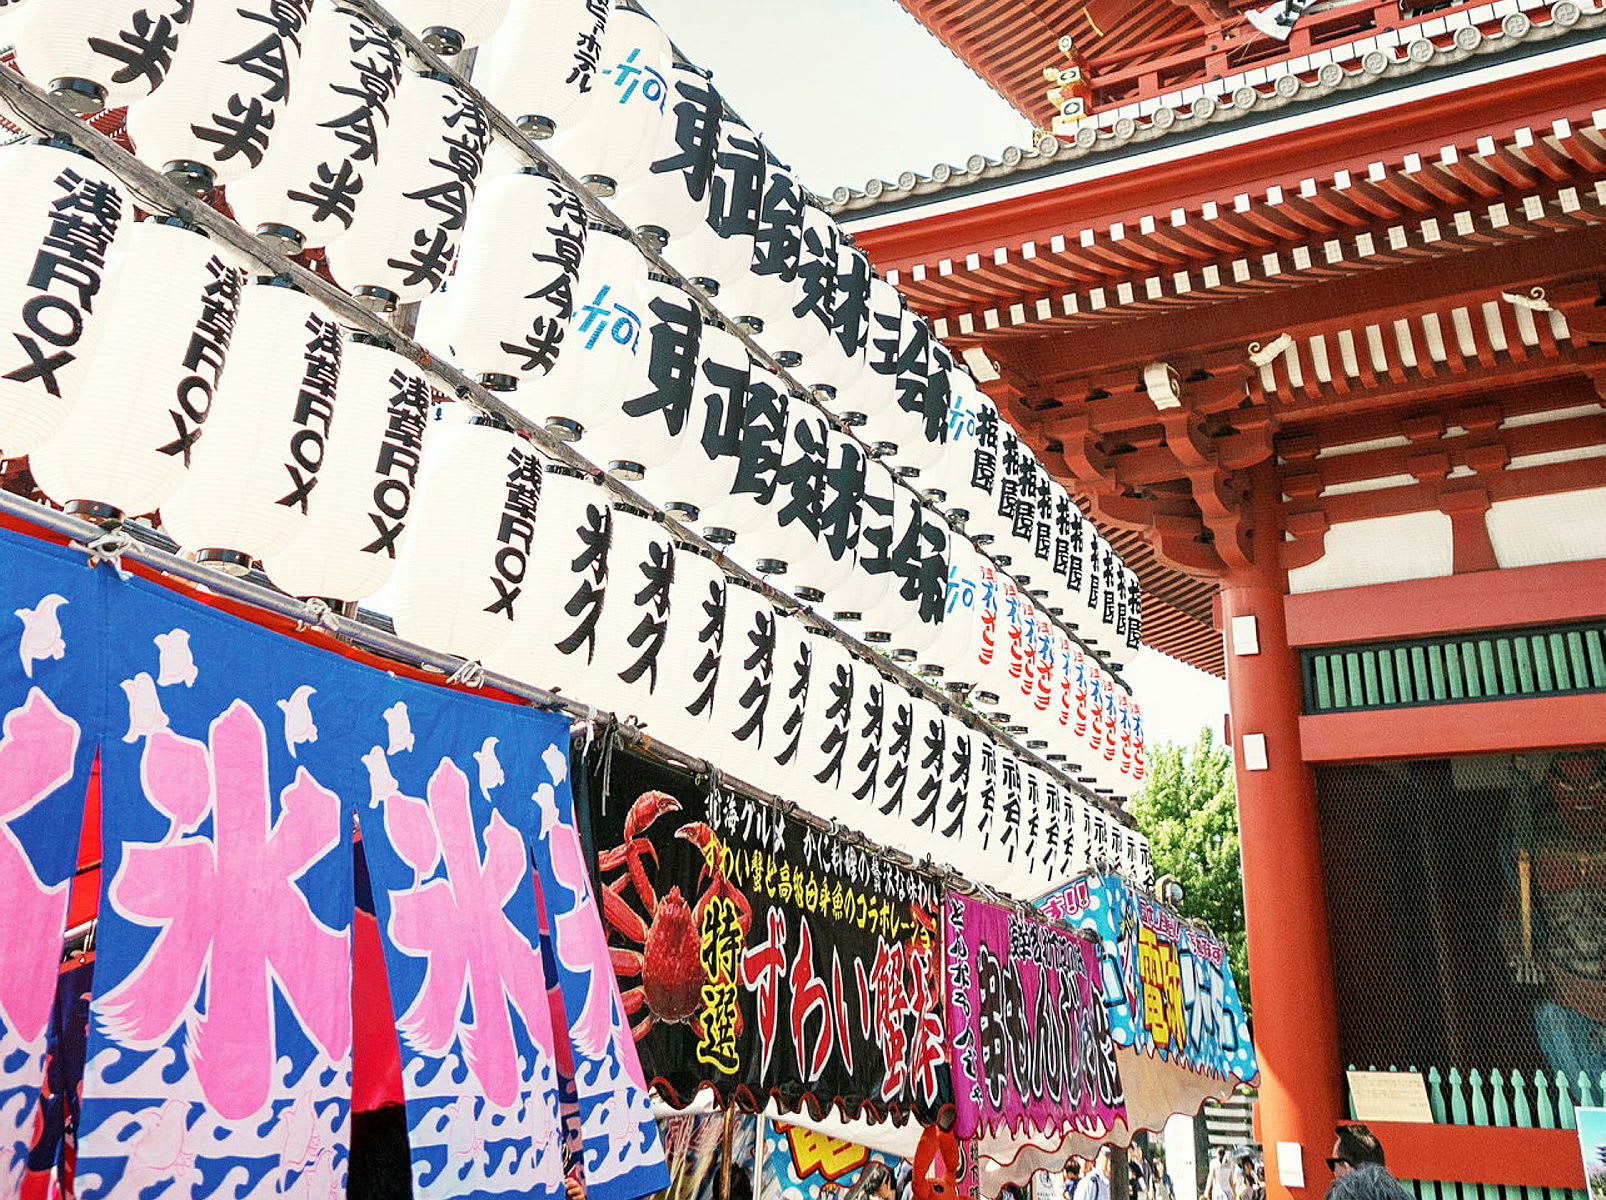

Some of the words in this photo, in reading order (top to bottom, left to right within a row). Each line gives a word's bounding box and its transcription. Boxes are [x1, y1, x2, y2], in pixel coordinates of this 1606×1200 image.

[1, 167, 122, 398] 浅草ROX
[156, 254, 248, 469] 浅草ROX
[274, 312, 343, 516] 浅草ROX
[360, 369, 430, 559] 浅草ROX
[483, 447, 542, 621] 浅草ROX
[95, 698, 353, 1121] 氷
[385, 756, 555, 1109] 氷
[697, 896, 743, 1075] 特選
